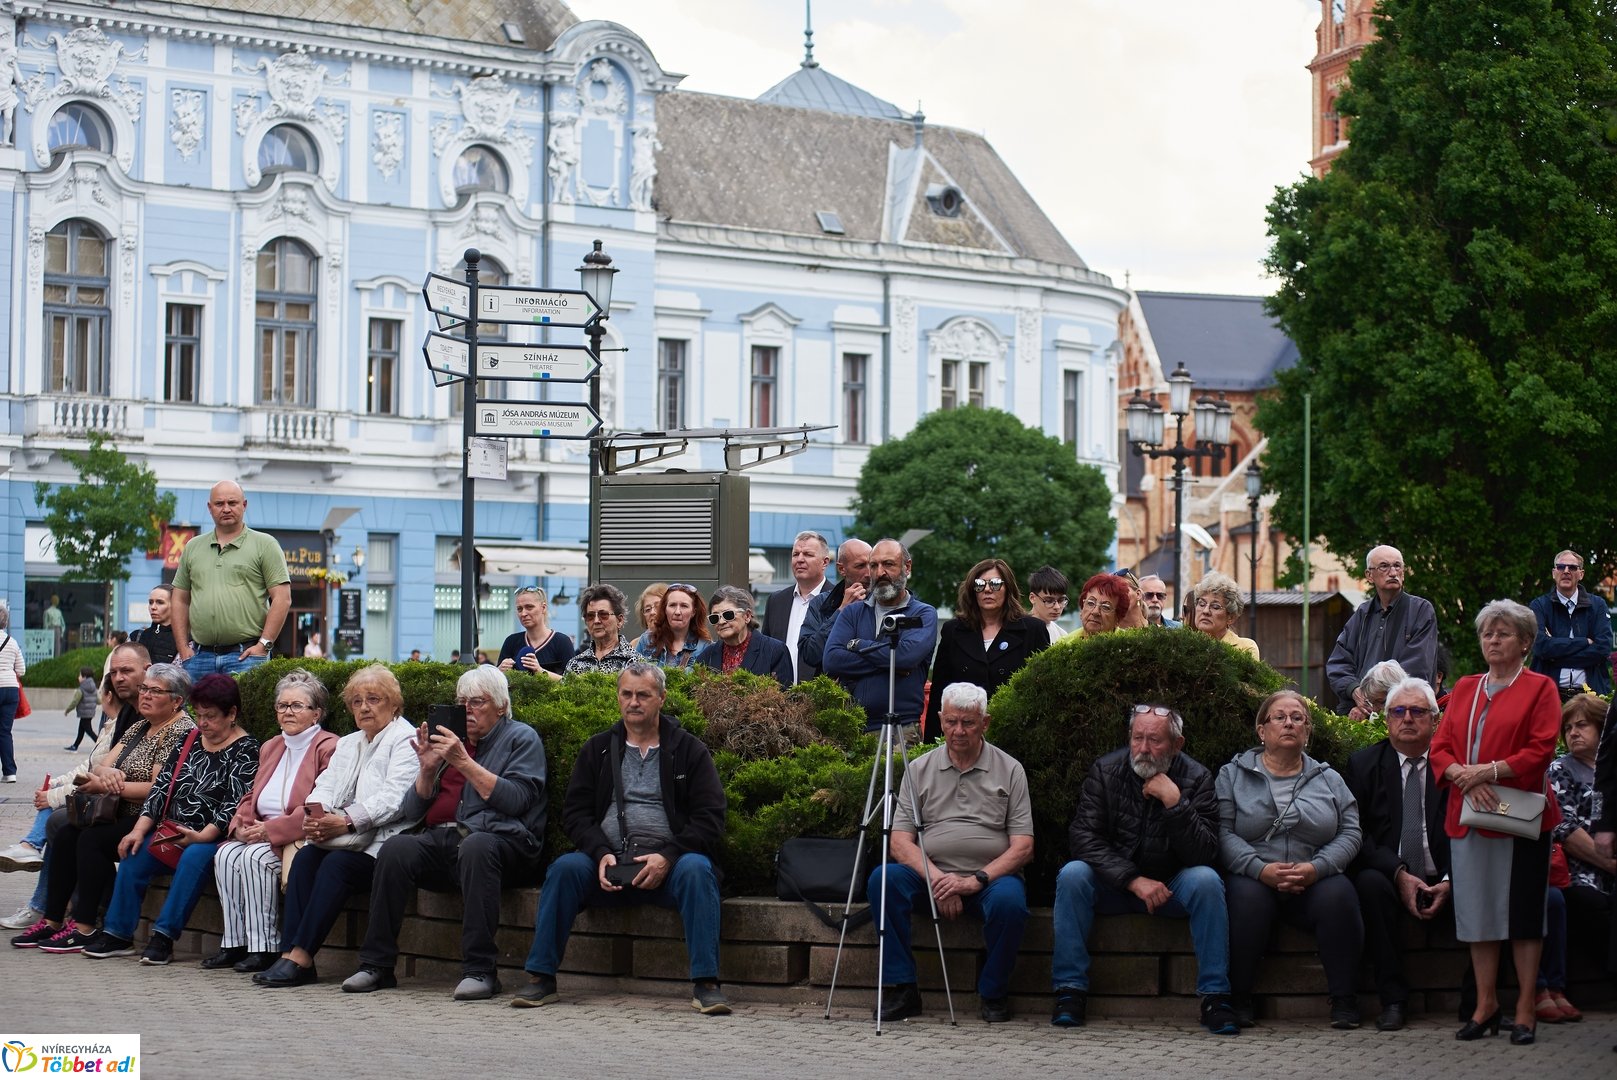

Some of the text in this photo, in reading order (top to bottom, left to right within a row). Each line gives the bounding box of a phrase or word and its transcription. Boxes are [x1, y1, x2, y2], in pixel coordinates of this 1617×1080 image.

[515, 297, 568, 307] INFORMÁCIÓ
[523, 353, 559, 362] SZÍNHÁZ
[501, 409, 580, 419] JÓSA ANDRÁS MÚZEUM
